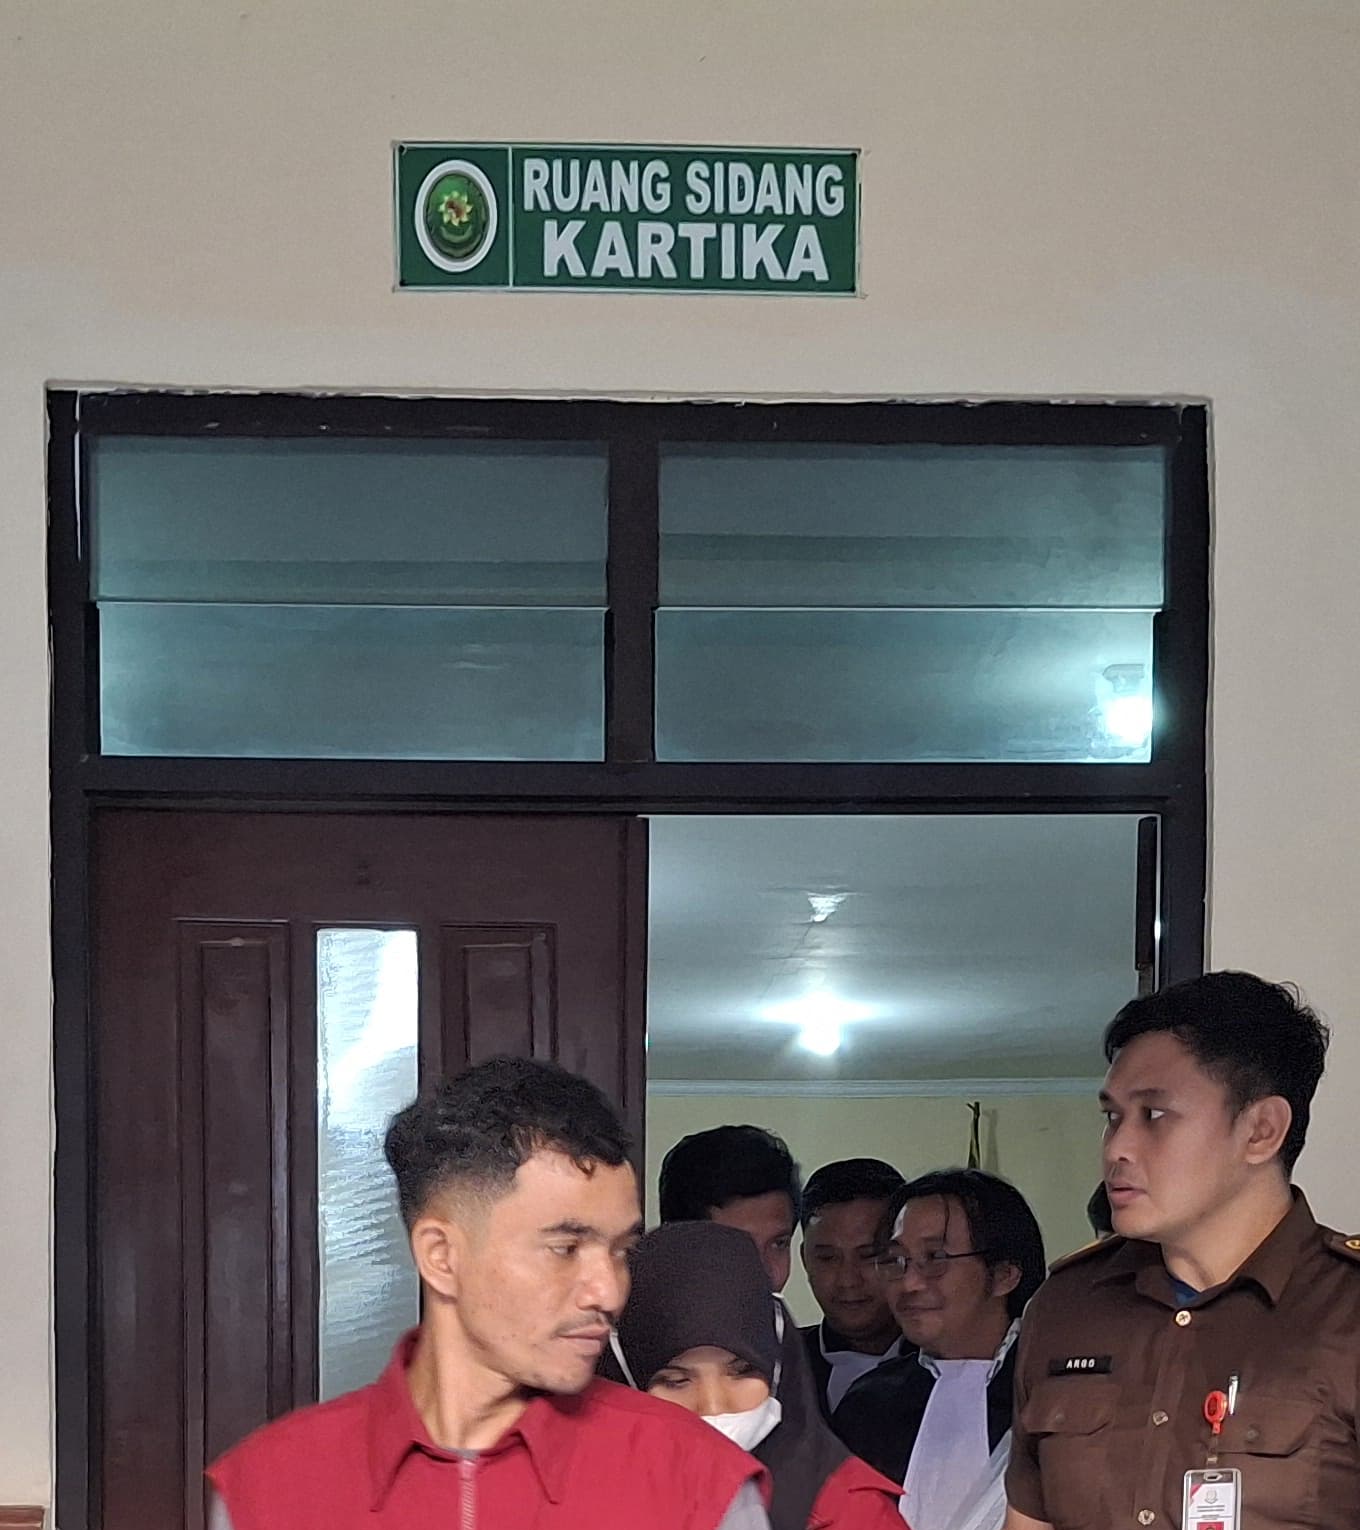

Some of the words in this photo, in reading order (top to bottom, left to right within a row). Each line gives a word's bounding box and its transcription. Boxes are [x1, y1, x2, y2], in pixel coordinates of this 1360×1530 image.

[523, 158, 671, 214] RUANG
[685, 160, 846, 217] SIDANG
[542, 219, 830, 282] KARTIKA
